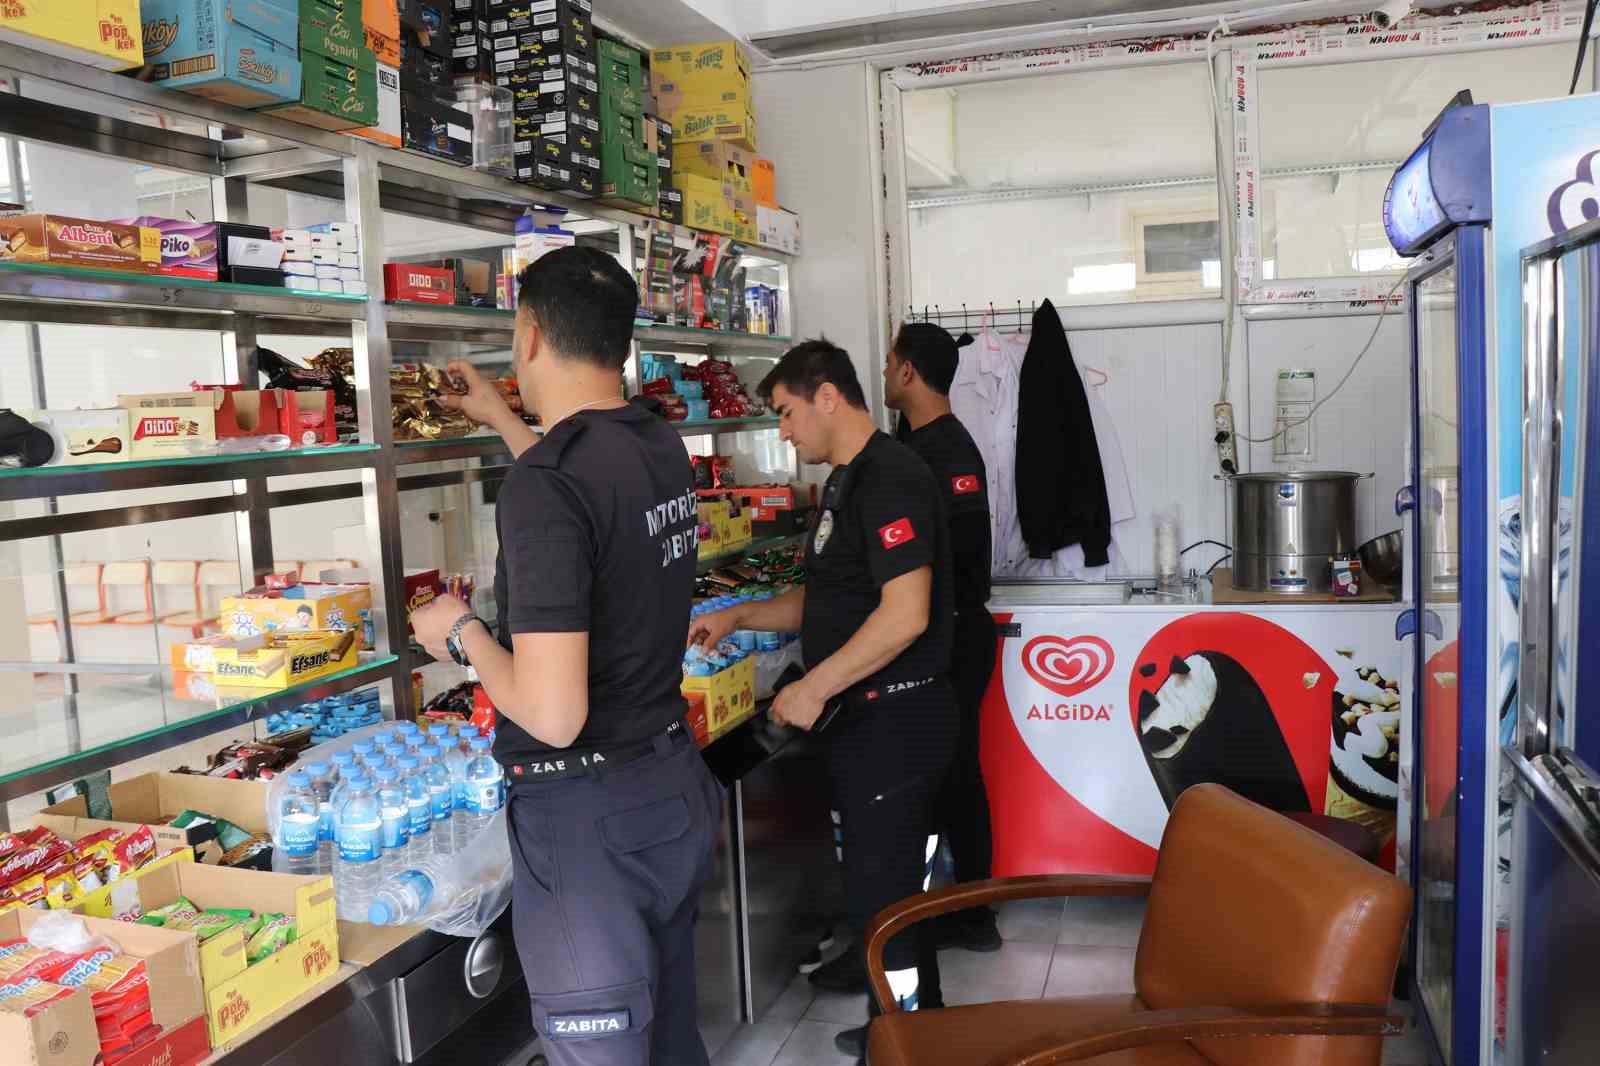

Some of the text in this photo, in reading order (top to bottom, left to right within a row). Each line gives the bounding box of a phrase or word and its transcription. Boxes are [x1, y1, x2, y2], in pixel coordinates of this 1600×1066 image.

[1369, 33, 1408, 45] ADAPEN
[1237, 77, 1246, 112] ADAPEN
[59, 225, 113, 245] Albeni
[161, 238, 190, 253] Piko
[292, 649, 329, 674] Efsane
[555, 1018, 620, 1033] ZABITA
